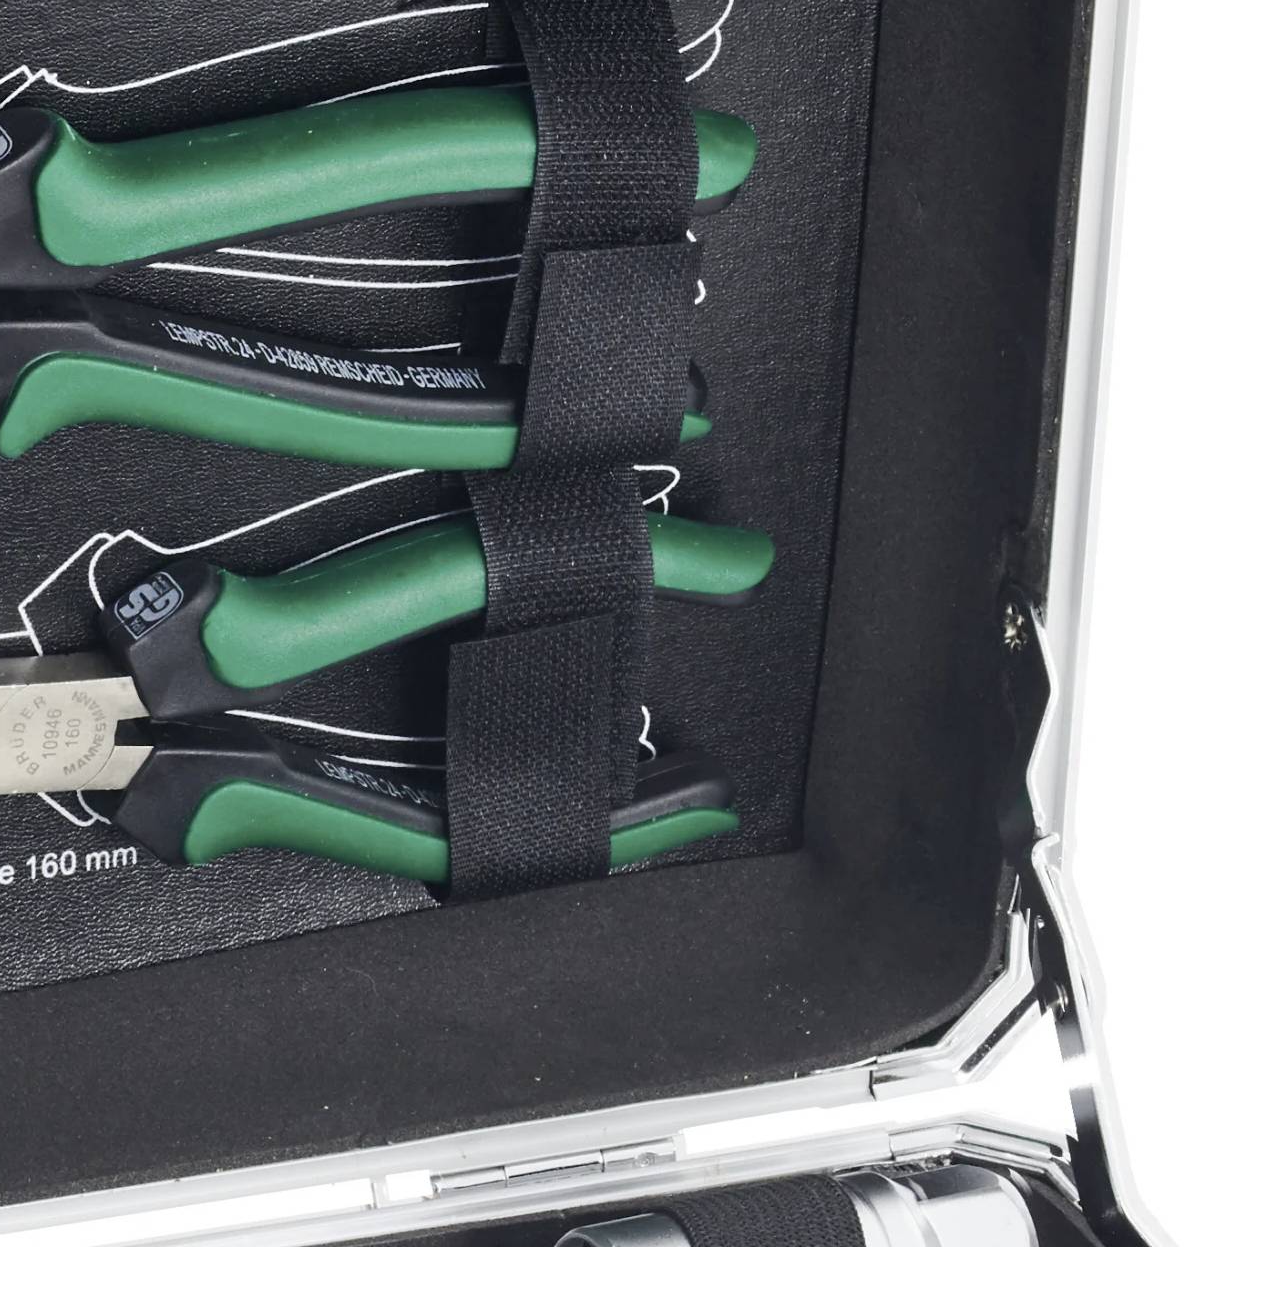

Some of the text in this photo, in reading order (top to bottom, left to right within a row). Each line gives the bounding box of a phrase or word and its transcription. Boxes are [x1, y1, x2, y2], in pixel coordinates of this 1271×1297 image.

[42, 708, 62, 759] 10946
[63, 691, 107, 775] MANNESMANN
[65, 718, 81, 748] 160
[26, 850, 77, 880] 160
[85, 846, 138, 871] mm
